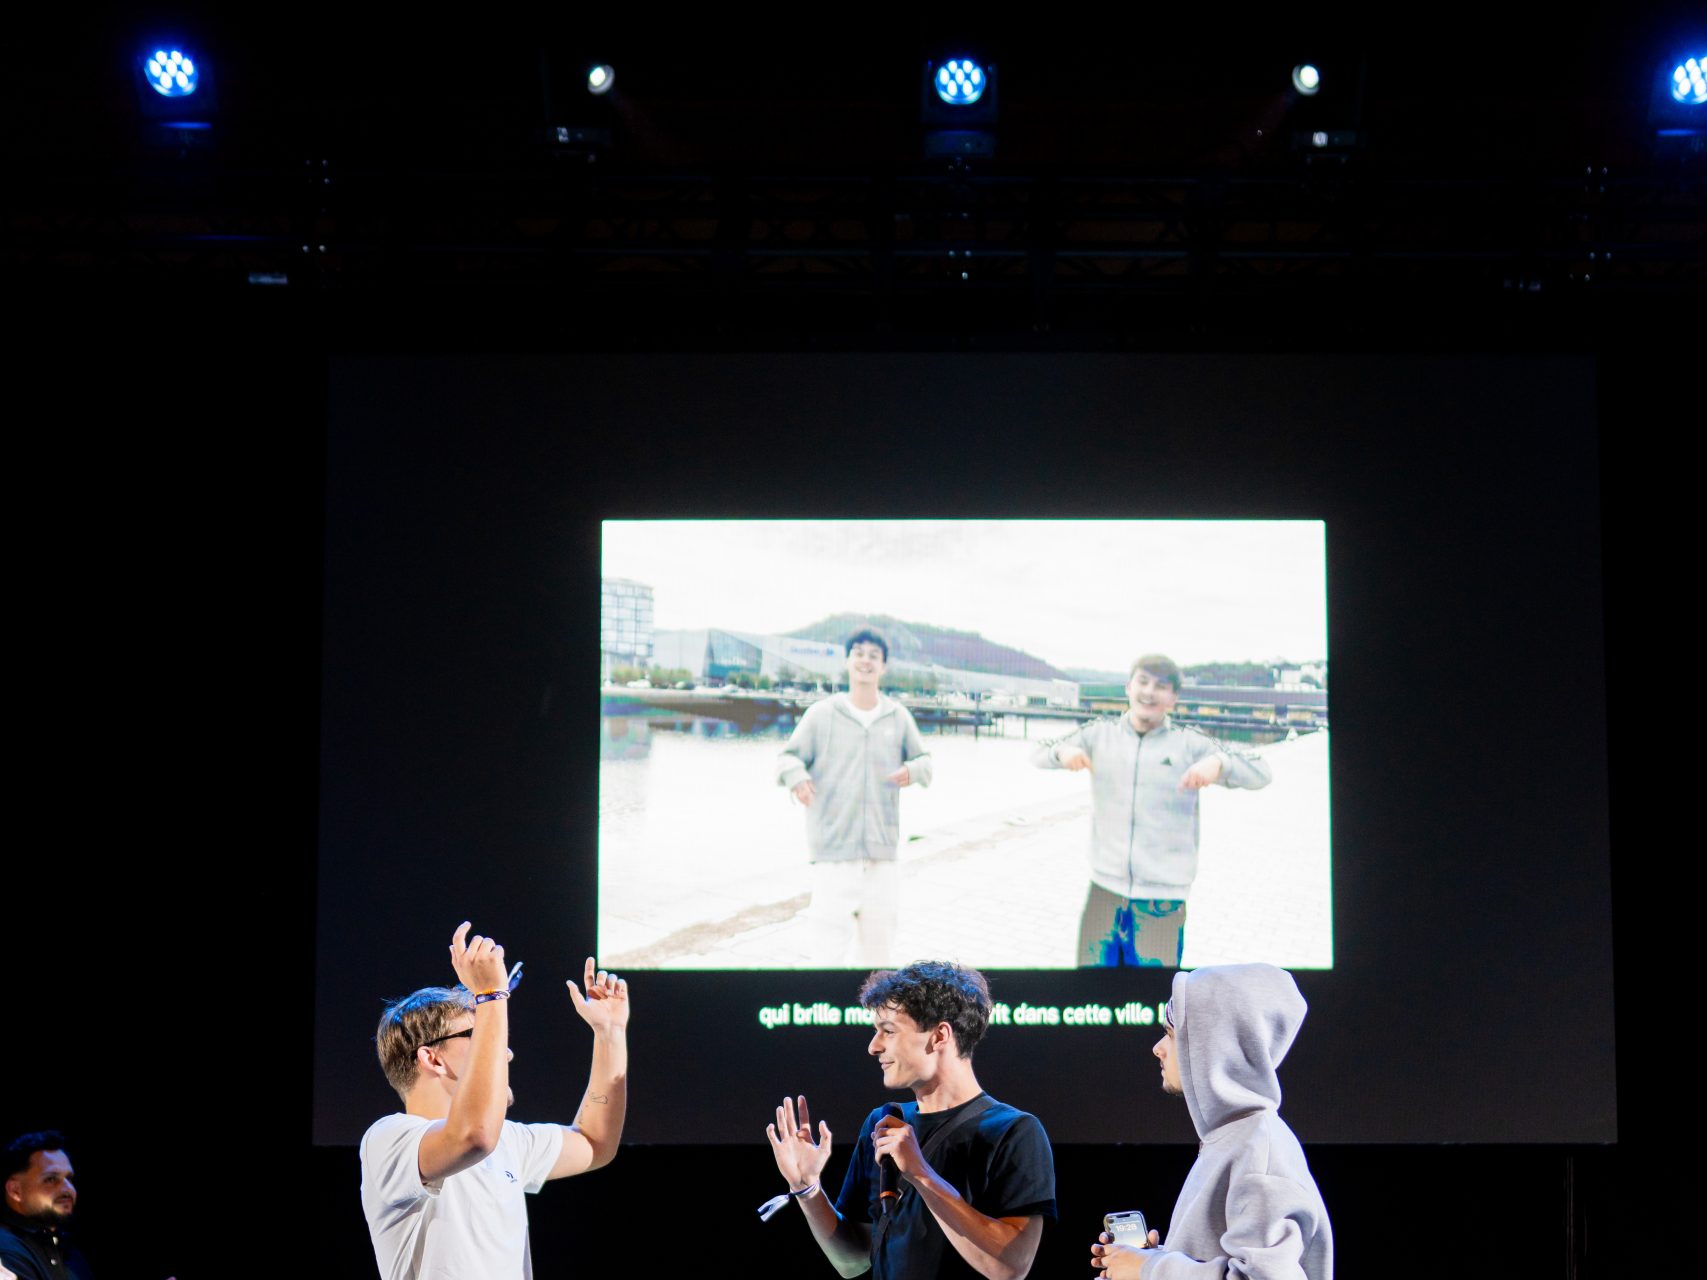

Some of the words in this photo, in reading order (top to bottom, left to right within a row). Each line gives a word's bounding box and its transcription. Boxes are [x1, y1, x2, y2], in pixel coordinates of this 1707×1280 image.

[759, 1003, 790, 1029] qui
[793, 1002, 842, 1025] brille
[845, 1005, 876, 1025] mo
[987, 1002, 1011, 1024] rit
[1013, 1002, 1060, 1025] dans
[1063, 1004, 1112, 1025] cette
[1115, 1002, 1154, 1025] ville
